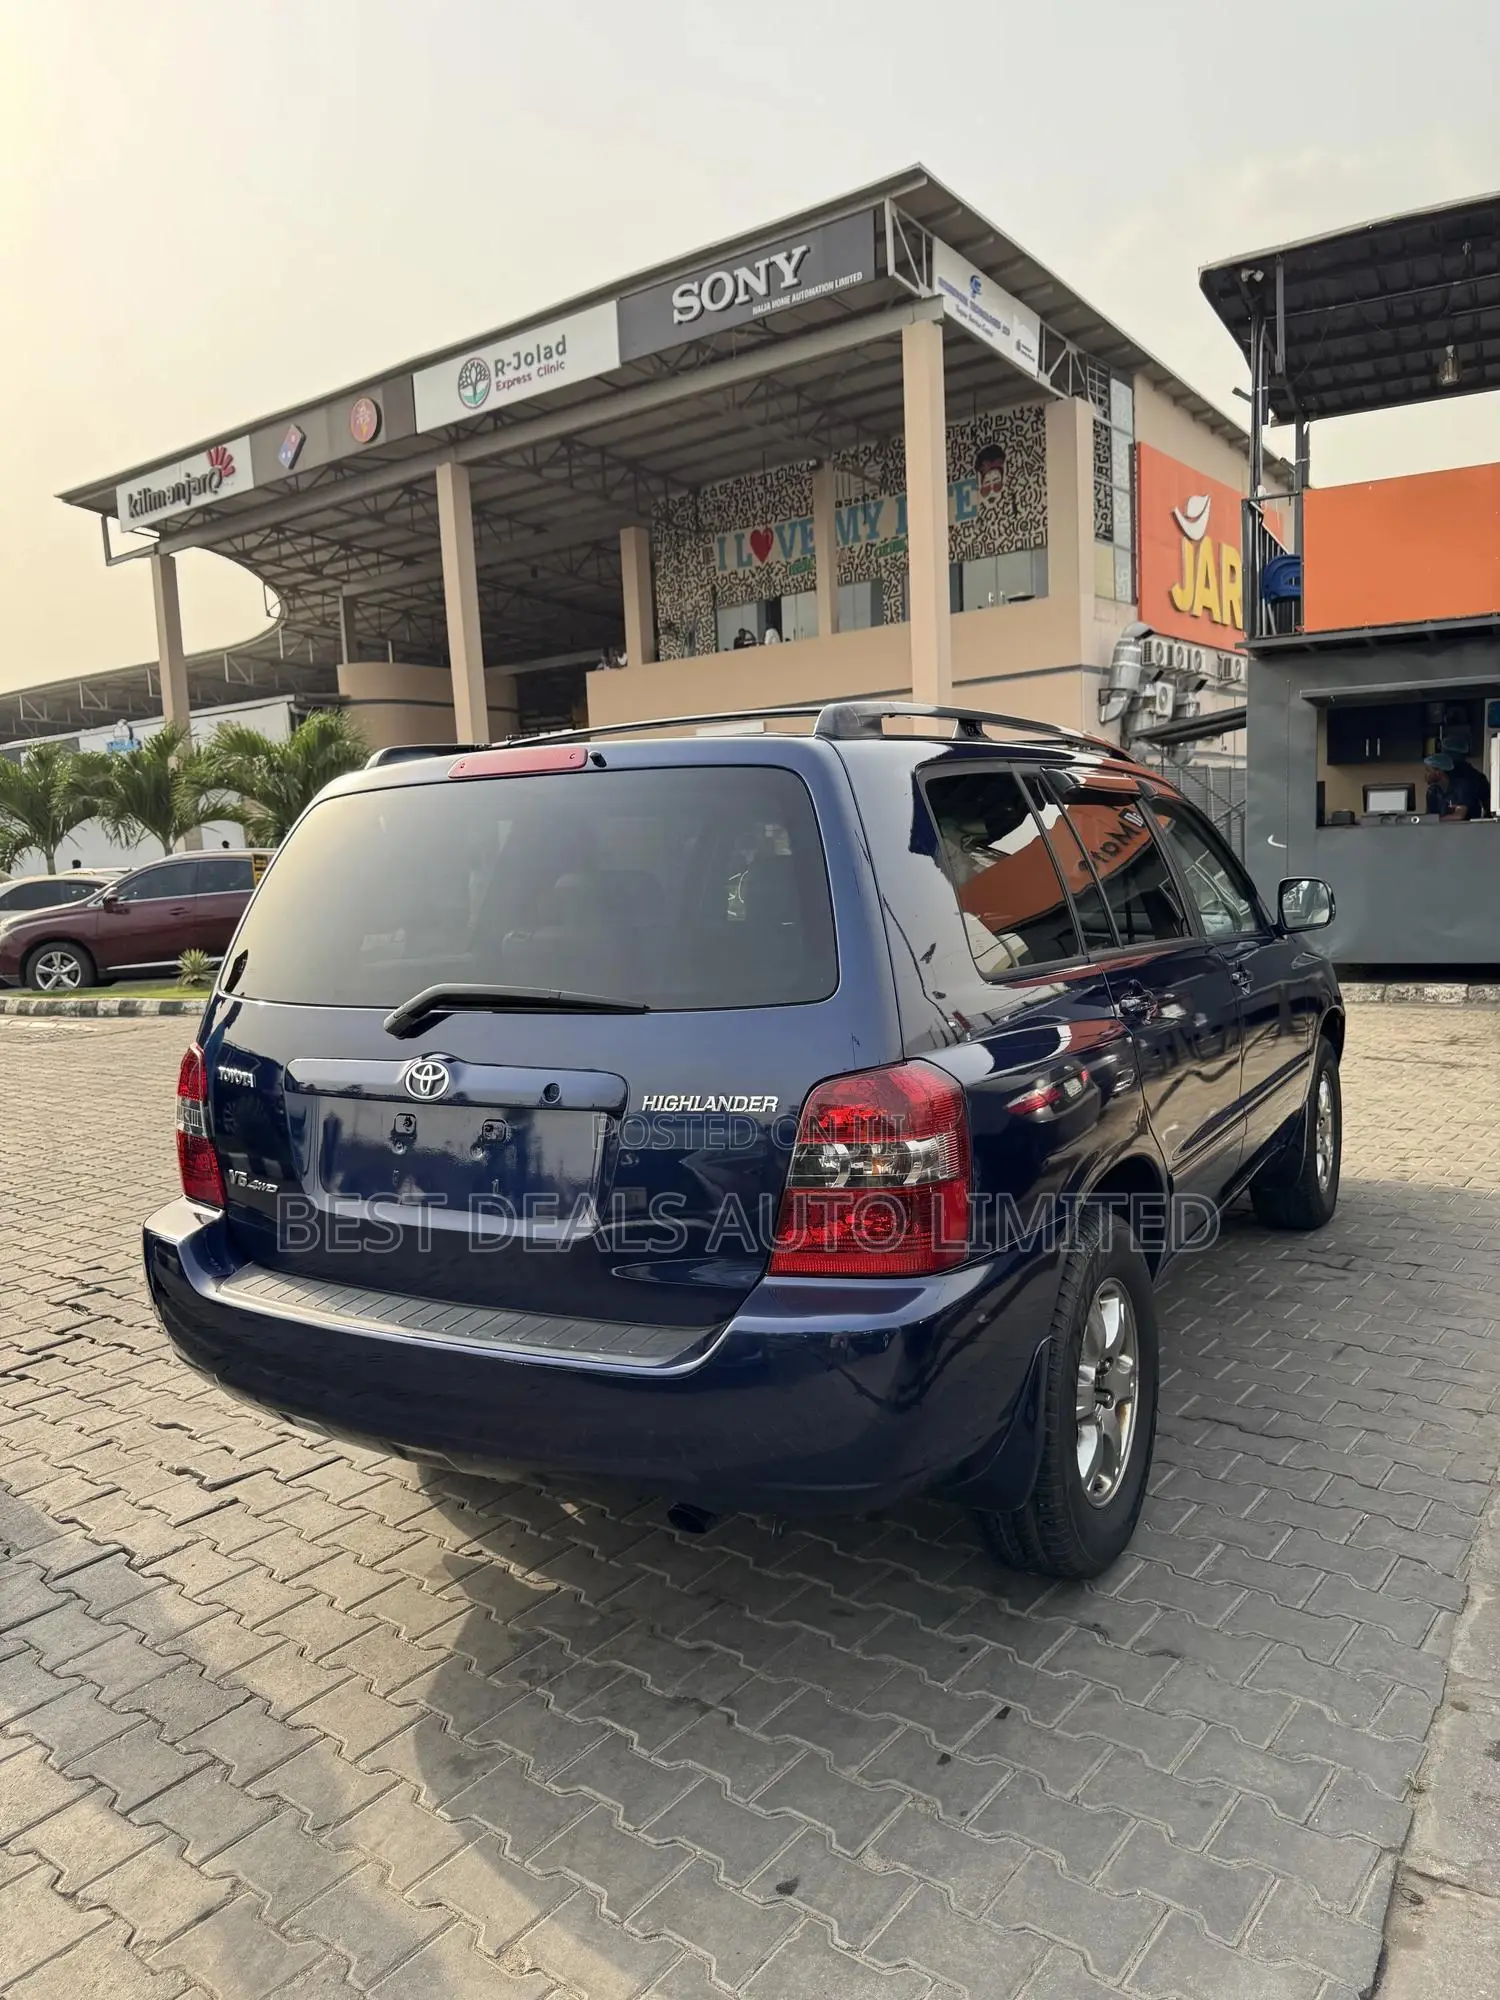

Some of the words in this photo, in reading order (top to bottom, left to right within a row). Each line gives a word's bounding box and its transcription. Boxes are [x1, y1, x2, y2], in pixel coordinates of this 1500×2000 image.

[672, 244, 810, 324] SONY
[771, 295, 791, 310] HOME
[792, 281, 835, 302] AUTOMATION
[835, 271, 864, 289] LIMITED
[494, 334, 567, 378] R-Jolad
[495, 372, 533, 392] Express
[536, 361, 566, 379] Clinic
[127, 467, 223, 519] kilimanjaro
[716, 536, 728, 571] I
[834, 500, 885, 547] MY
[217, 1066, 257, 1088] TOYOTA
[641, 1094, 779, 1113] HIGHLANDER
[229, 1169, 248, 1187] V6
[247, 1179, 279, 1192] 4WD
